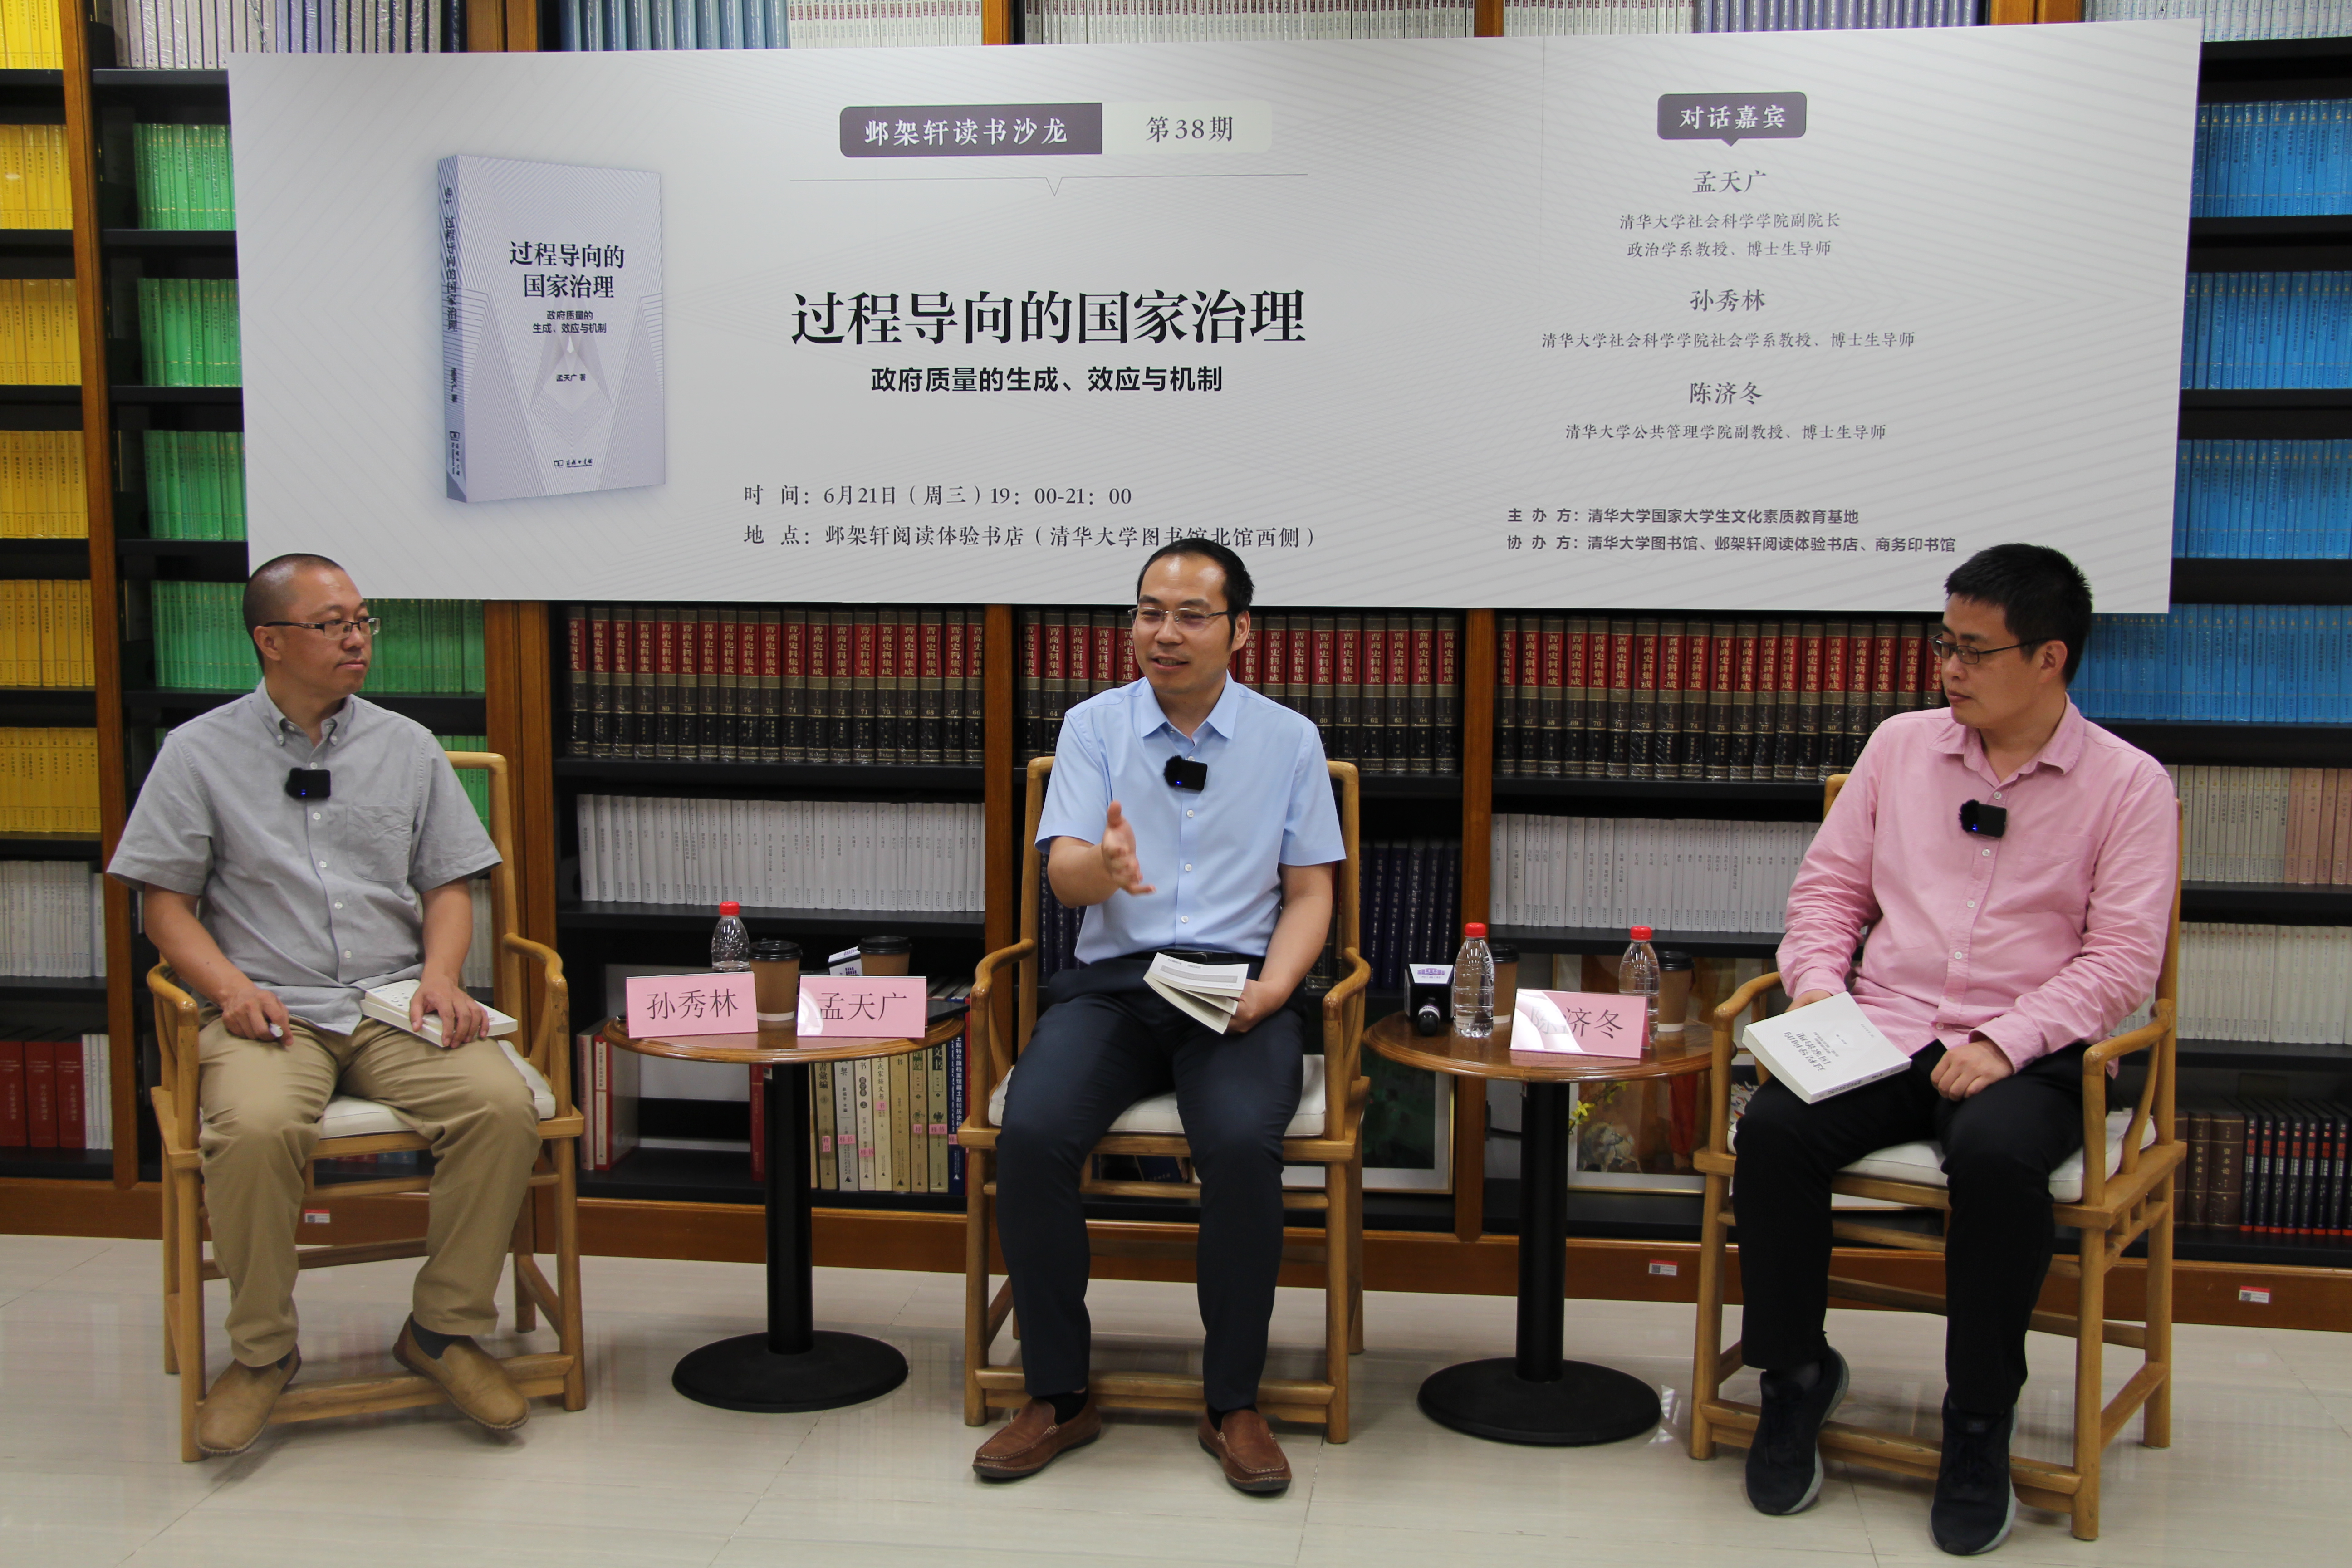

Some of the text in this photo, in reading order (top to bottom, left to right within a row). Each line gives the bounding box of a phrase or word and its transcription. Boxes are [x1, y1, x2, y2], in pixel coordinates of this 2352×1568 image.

[1680, 105, 1785, 129] 对话嘉宾
[865, 118, 1067, 146] 邺架轩读书沙龙
[1147, 116, 1232, 142] 第38期
[1693, 170, 1766, 192] 孟天广
[1620, 213, 1839, 230] 清华大学社会科学学院副院长
[510, 241, 625, 268] 过程导向的
[1627, 241, 1831, 257] 政治学系教授、博士生导师
[524, 274, 614, 298] 国家治理
[1690, 289, 1765, 312] 孙秀林
[547, 310, 593, 321] 政府质量的
[792, 289, 1305, 344] 过程导向的国家治理
[533, 322, 607, 334] 生成、效应与机制
[1543, 332, 1914, 348] 清华大学社会科学学院社会学系教授、博士生导师
[872, 366, 1221, 392] 政府质量的生成、效应与机制
[1690, 382, 1762, 404] 陈济冬
[1566, 424, 1886, 440] 清华大学公共管理学院副教授、博士生导师
[647, 989, 738, 1019] 孙秀林
[817, 991, 907, 1022] 孟天广
[931, 1125, 945, 1133] 样书
